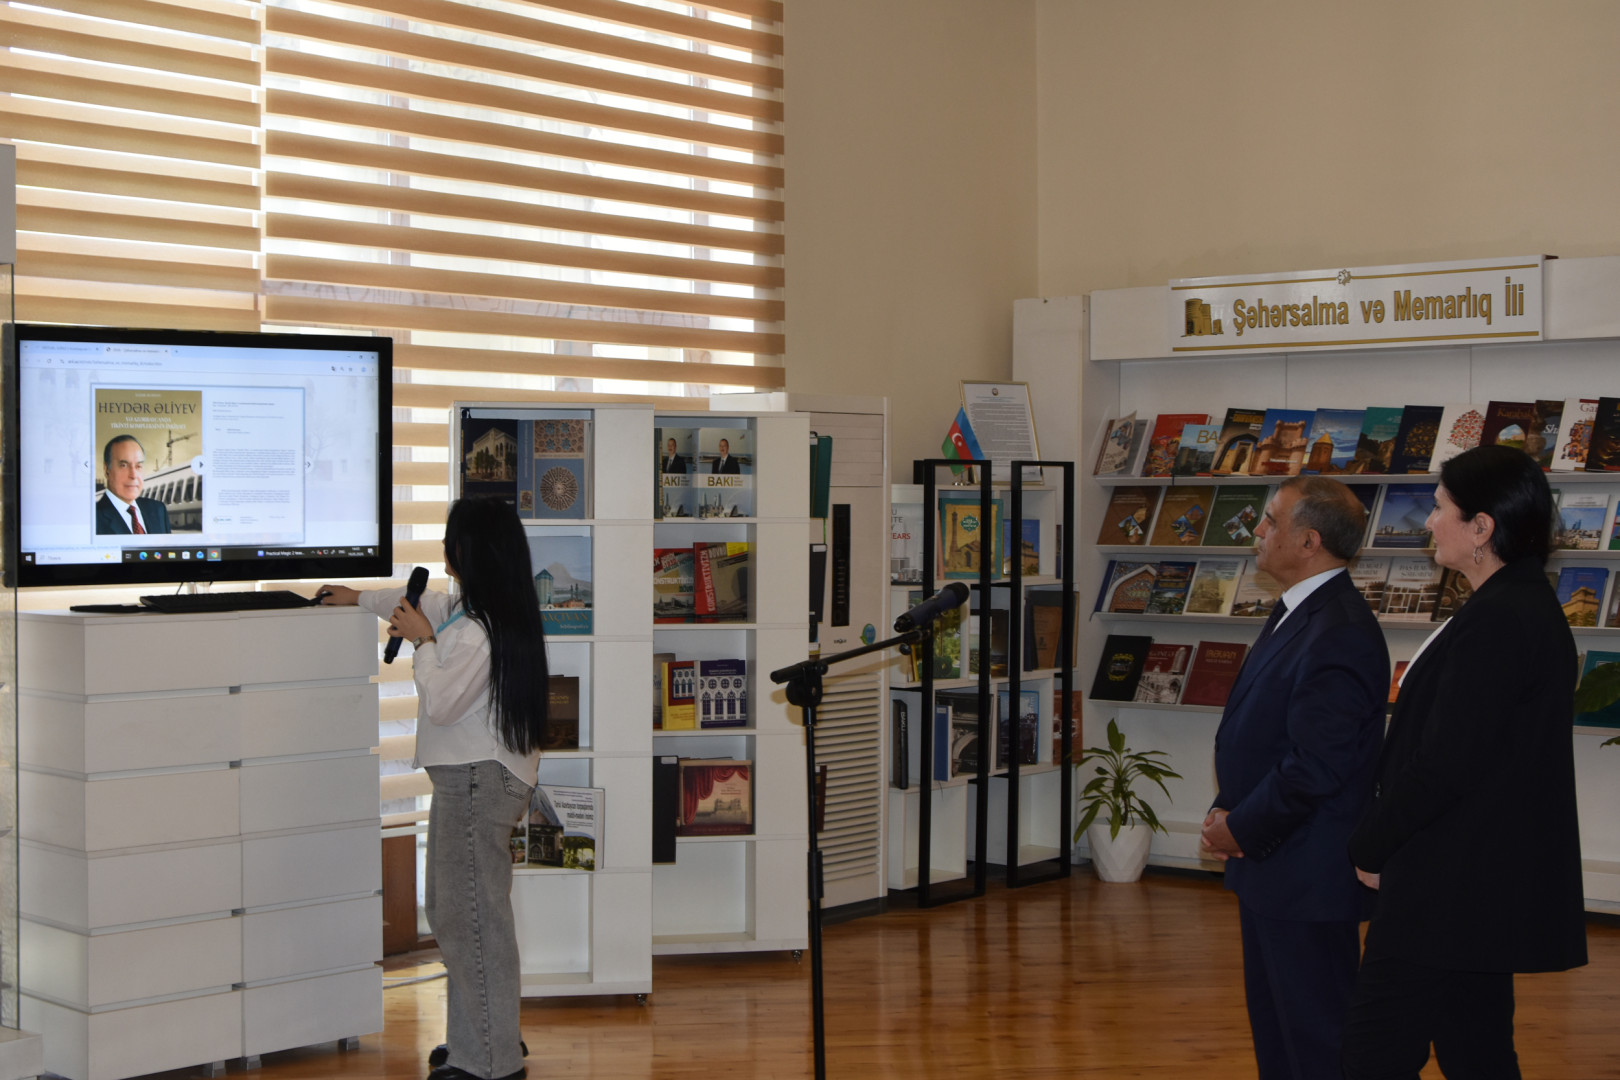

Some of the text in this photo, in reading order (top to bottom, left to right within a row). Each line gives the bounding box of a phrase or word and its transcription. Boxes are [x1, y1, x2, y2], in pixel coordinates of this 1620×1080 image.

[1233, 276, 1524, 336] Şəhərsalma və Memarlıq İli
[98, 402, 151, 414] HEYDƏR
[154, 401, 197, 414] ƏLİYEV
[663, 476, 680, 487] AKI
[707, 476, 734, 488] BAKI
[892, 532, 911, 540] EARS
